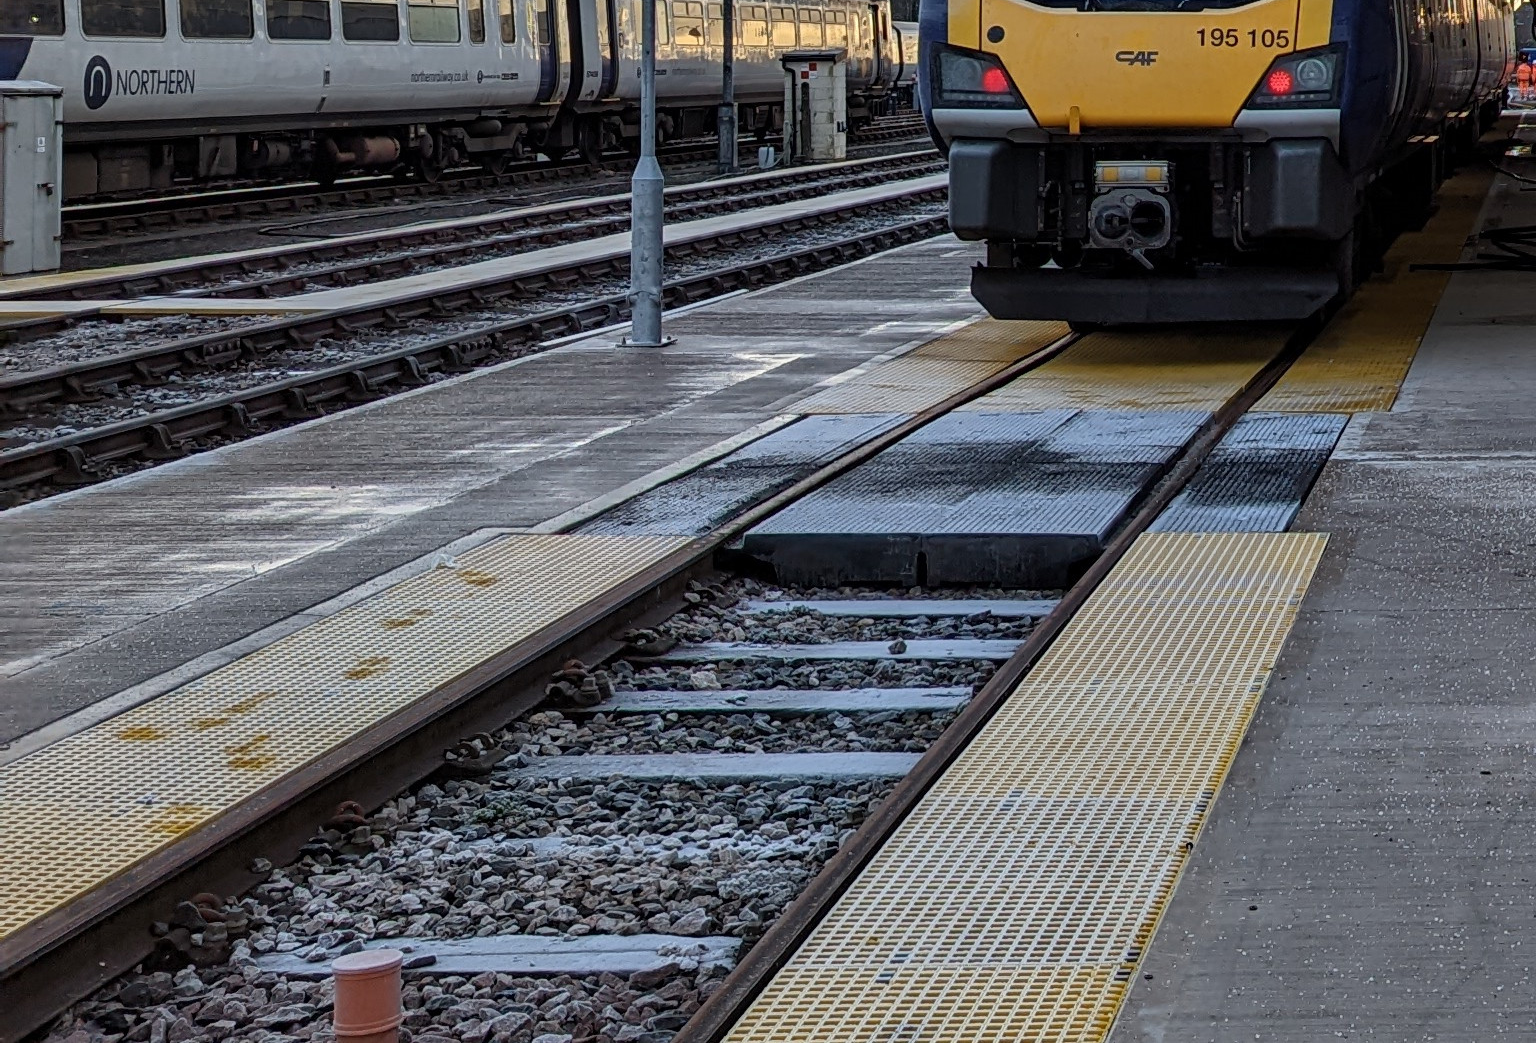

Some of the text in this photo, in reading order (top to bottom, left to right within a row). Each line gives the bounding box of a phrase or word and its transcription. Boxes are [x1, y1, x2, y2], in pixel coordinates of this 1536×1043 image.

[1196, 27, 1290, 49] 195 105
[1115, 50, 1159, 67] CAF
[115, 69, 196, 96] NORTHERN
